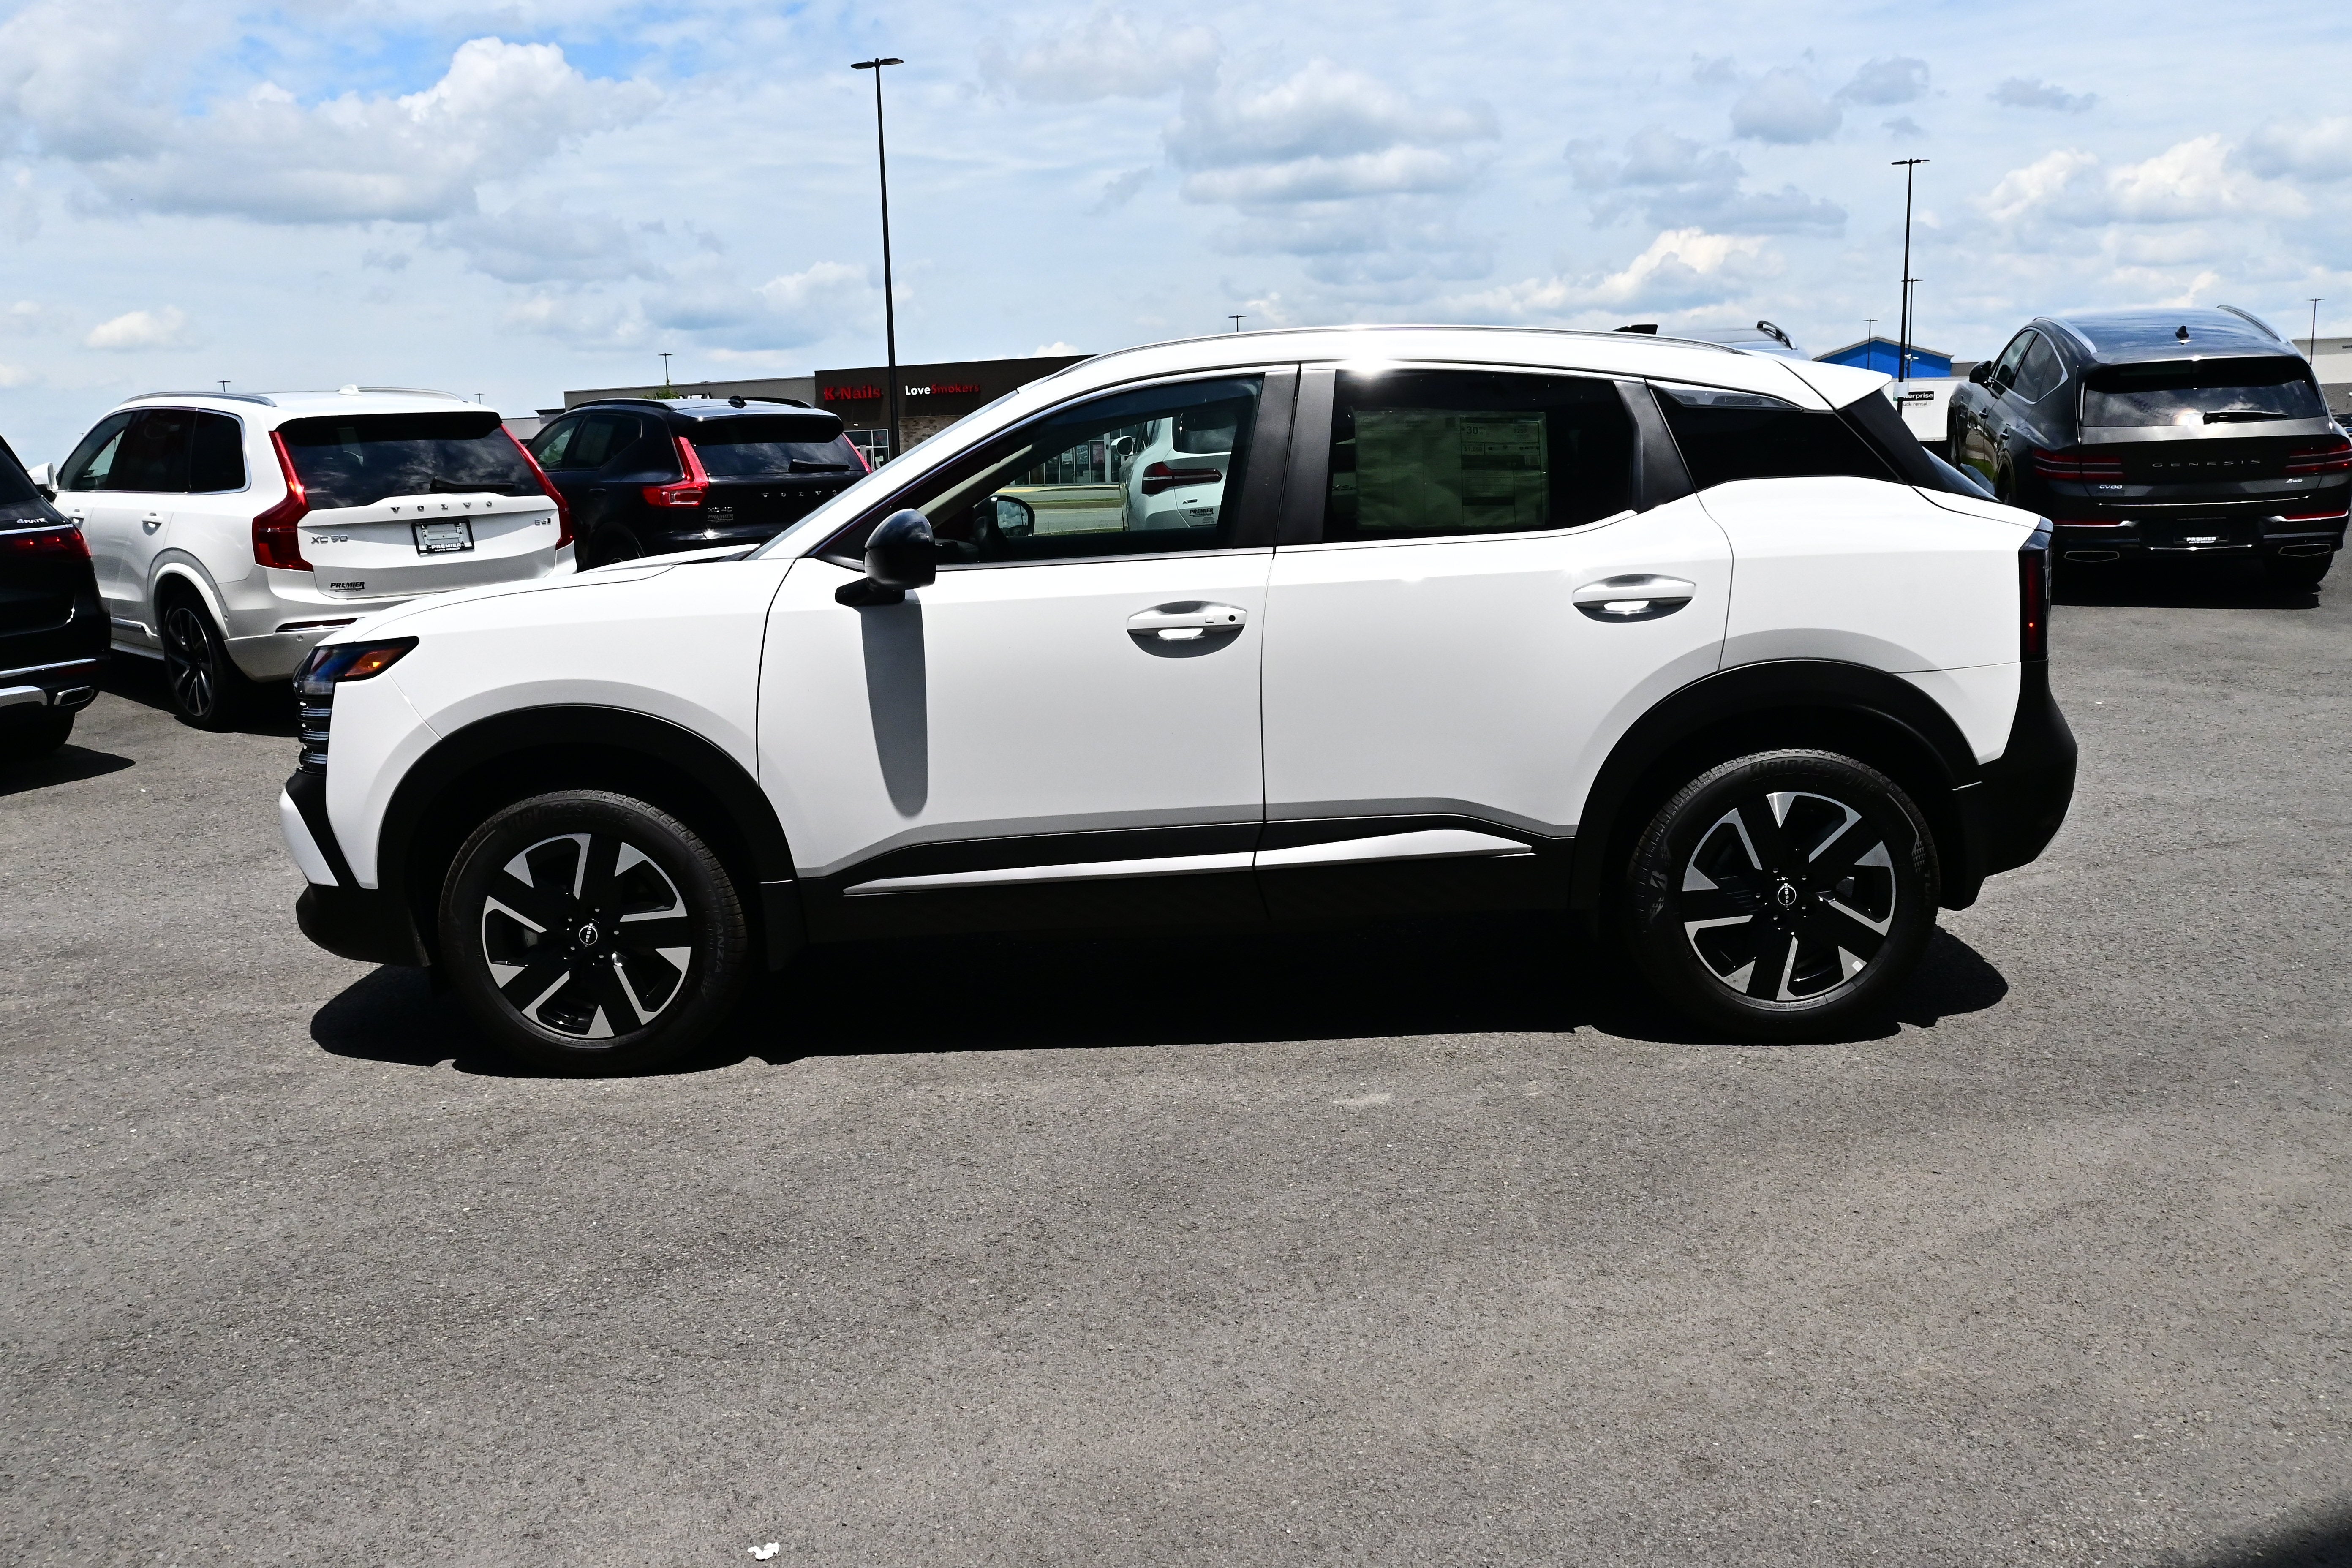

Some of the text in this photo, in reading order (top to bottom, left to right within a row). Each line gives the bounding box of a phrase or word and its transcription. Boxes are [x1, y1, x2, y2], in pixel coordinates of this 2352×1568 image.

[823, 384, 882, 400] K-Nails
[1467, 426, 1478, 434] 30
[2152, 459, 2261, 468] GENESIS
[390, 501, 493, 514] VOLVO
[330, 581, 365, 589] PREMIER
[707, 887, 724, 973] ANZA
